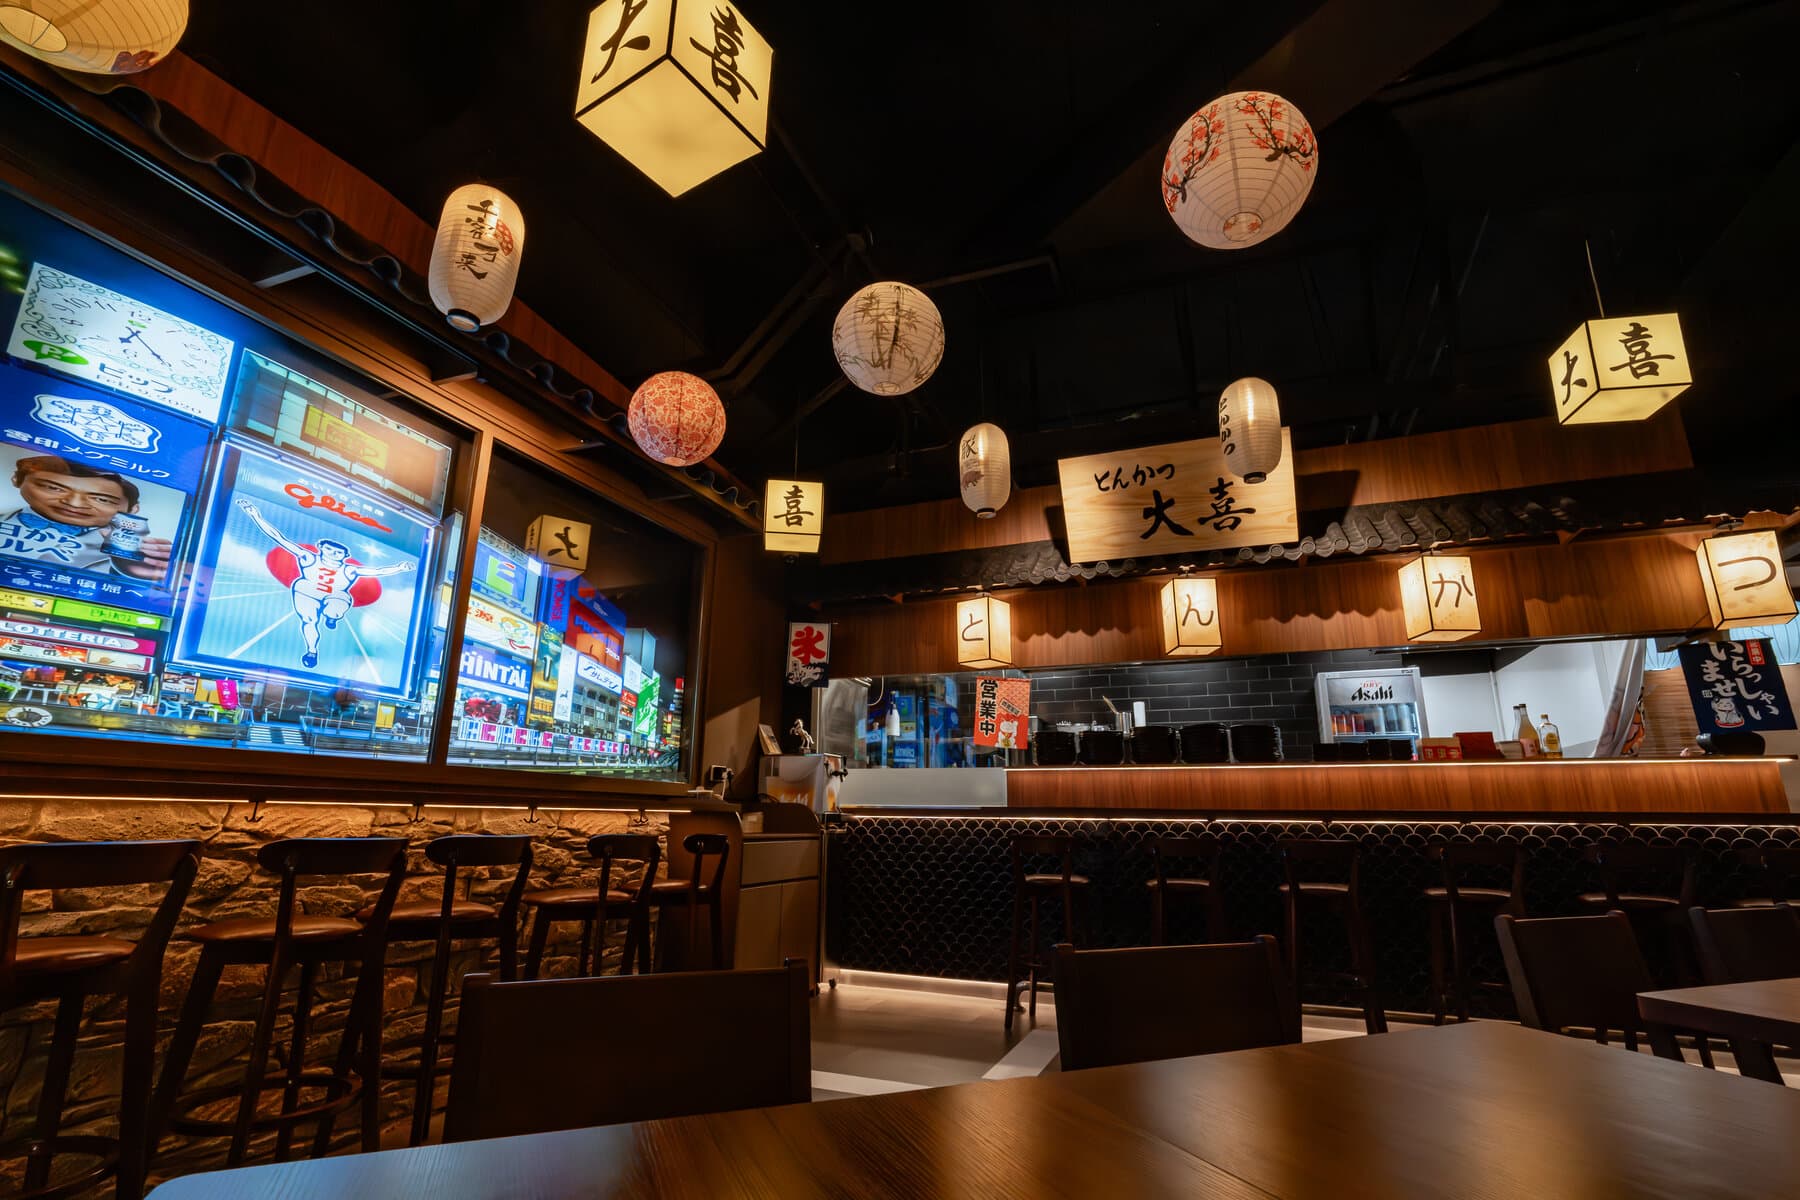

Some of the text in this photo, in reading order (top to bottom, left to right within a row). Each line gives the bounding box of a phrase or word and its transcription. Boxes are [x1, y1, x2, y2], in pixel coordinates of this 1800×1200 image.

[591, 0, 650, 84] 大
[690, 6, 759, 104] 喜
[1610, 322, 1676, 380] 喜
[1561, 350, 1588, 405] 大
[1094, 464, 1175, 491] とんかつ
[284, 484, 393, 533] Glico
[774, 485, 814, 527] 喜
[1139, 477, 1257, 540] 大喜
[1432, 573, 1473, 608] か
[1717, 556, 1777, 591] つ
[961, 613, 984, 642] と
[1181, 593, 1214, 626] ん
[4, 622, 123, 648] LOTTERIA
[791, 625, 826, 666] 氷
[460, 651, 527, 689] HINTAI
[1701, 660, 1737, 697] ませ
[980, 680, 998, 736] 営業中
[1351, 685, 1393, 701] Asahi
